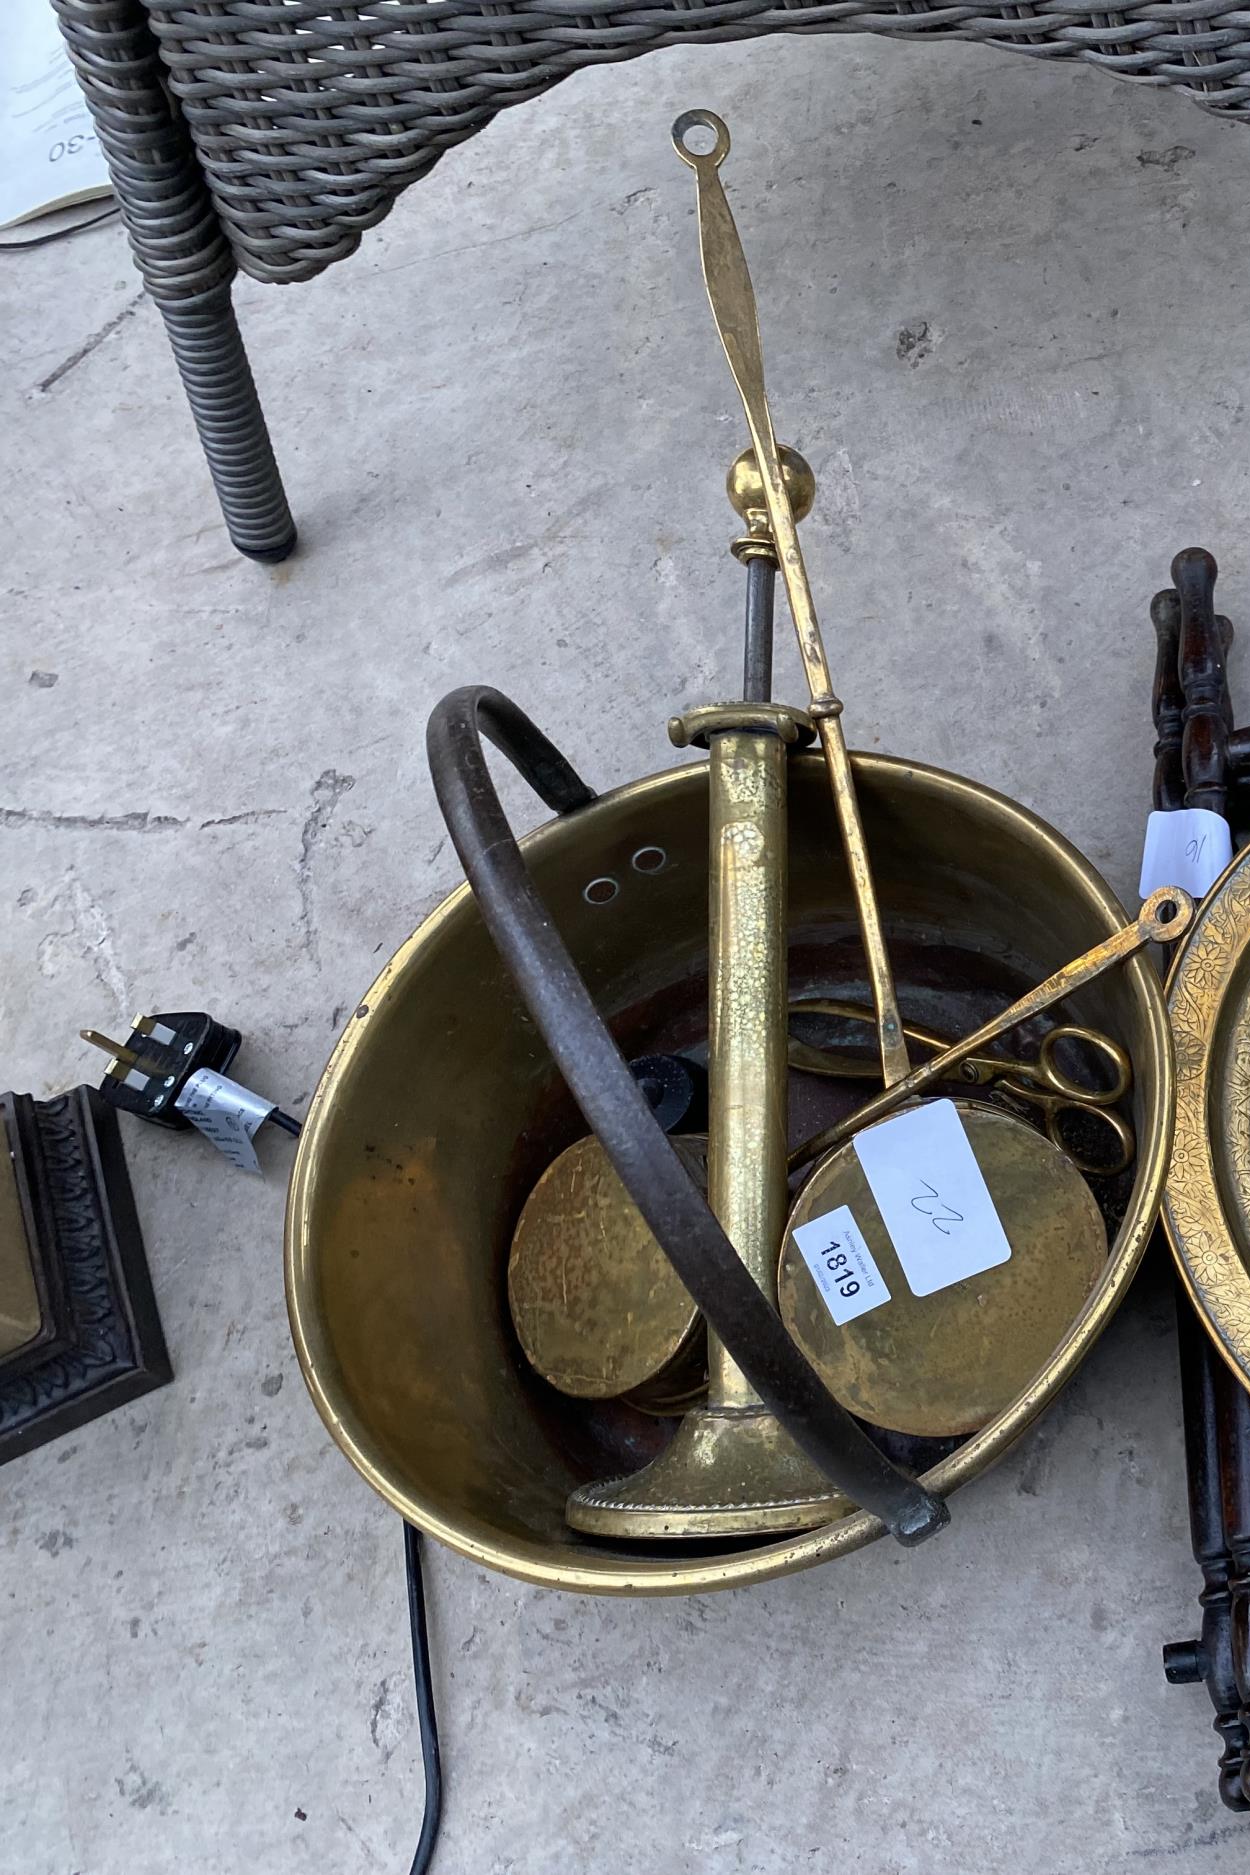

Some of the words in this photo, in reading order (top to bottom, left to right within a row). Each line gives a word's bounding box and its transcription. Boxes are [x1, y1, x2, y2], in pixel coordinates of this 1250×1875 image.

[910, 1178, 965, 1236] 22
[820, 1241, 862, 1298] 1819
[864, 1275, 875, 1288] Ltd
